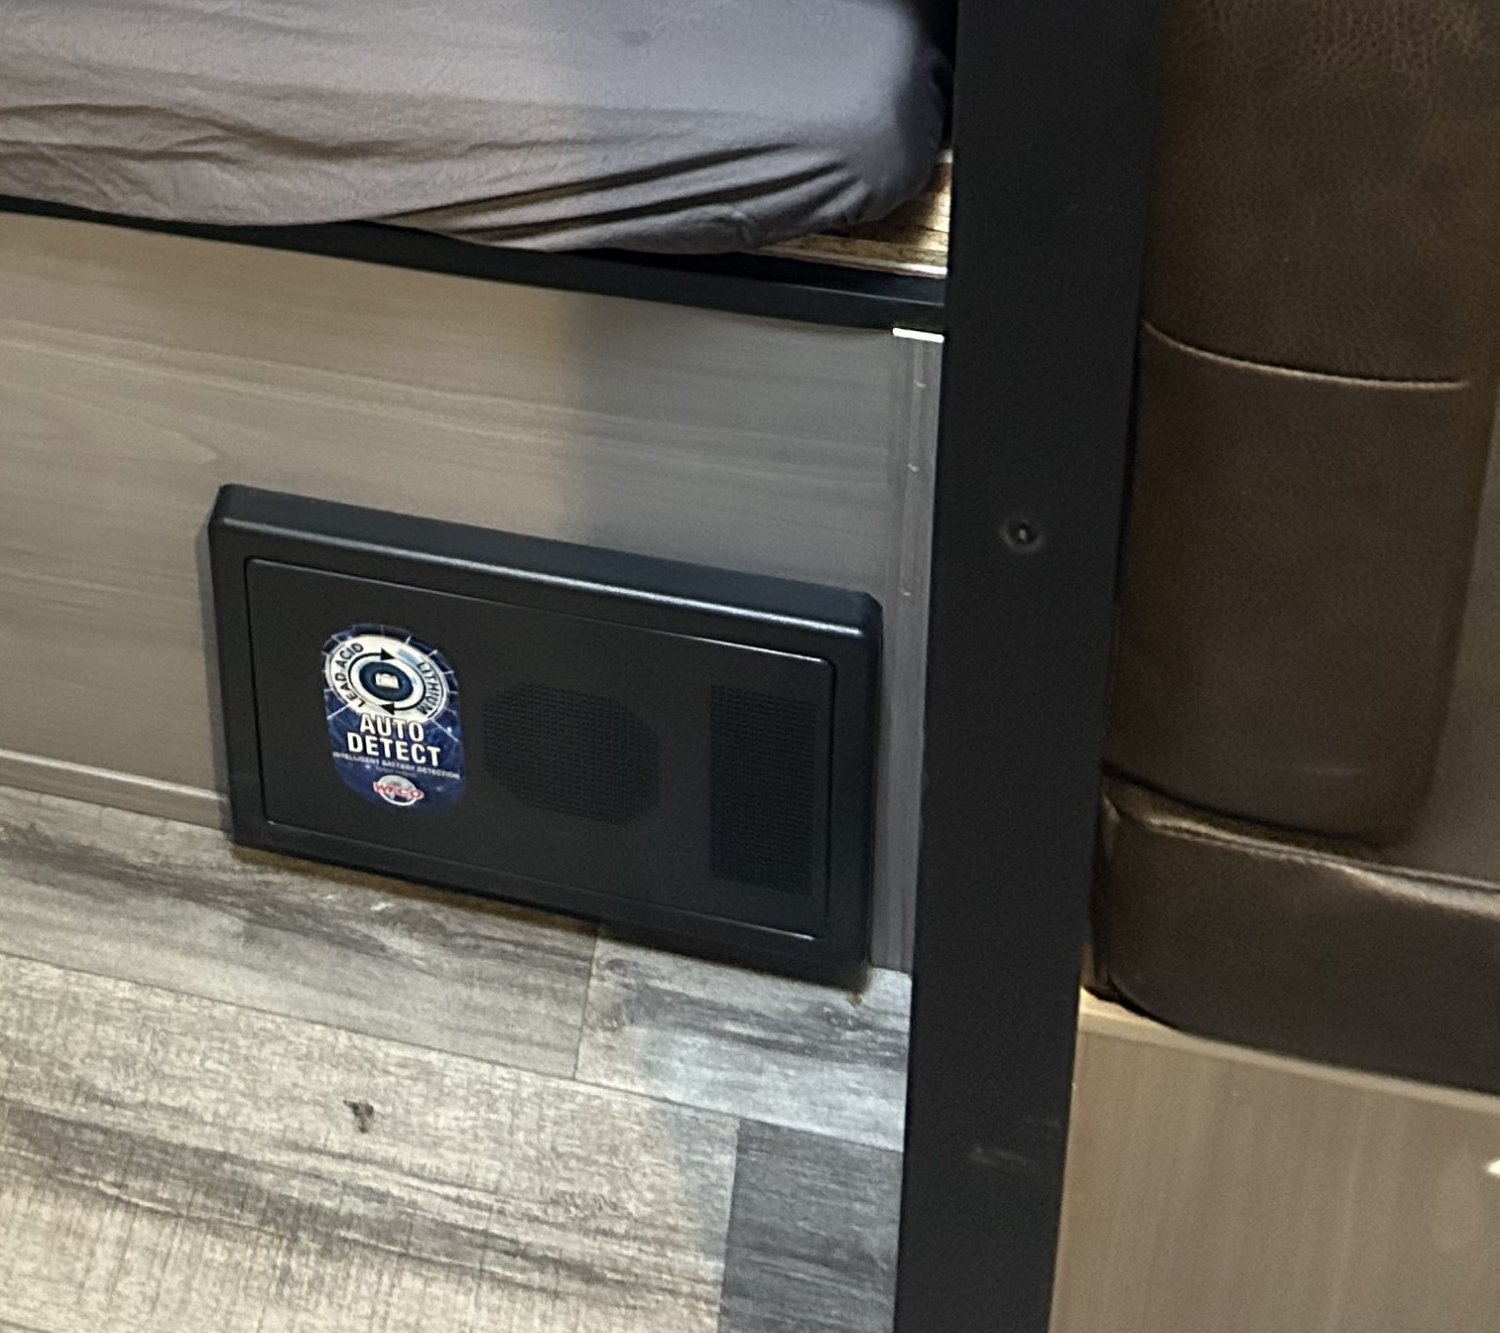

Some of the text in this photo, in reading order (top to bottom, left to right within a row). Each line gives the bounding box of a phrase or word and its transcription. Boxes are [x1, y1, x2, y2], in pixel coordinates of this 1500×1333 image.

[416, 660, 440, 715] LITHIUM
[360, 713, 425, 743] AUTO
[346, 731, 441, 767] DETECT
